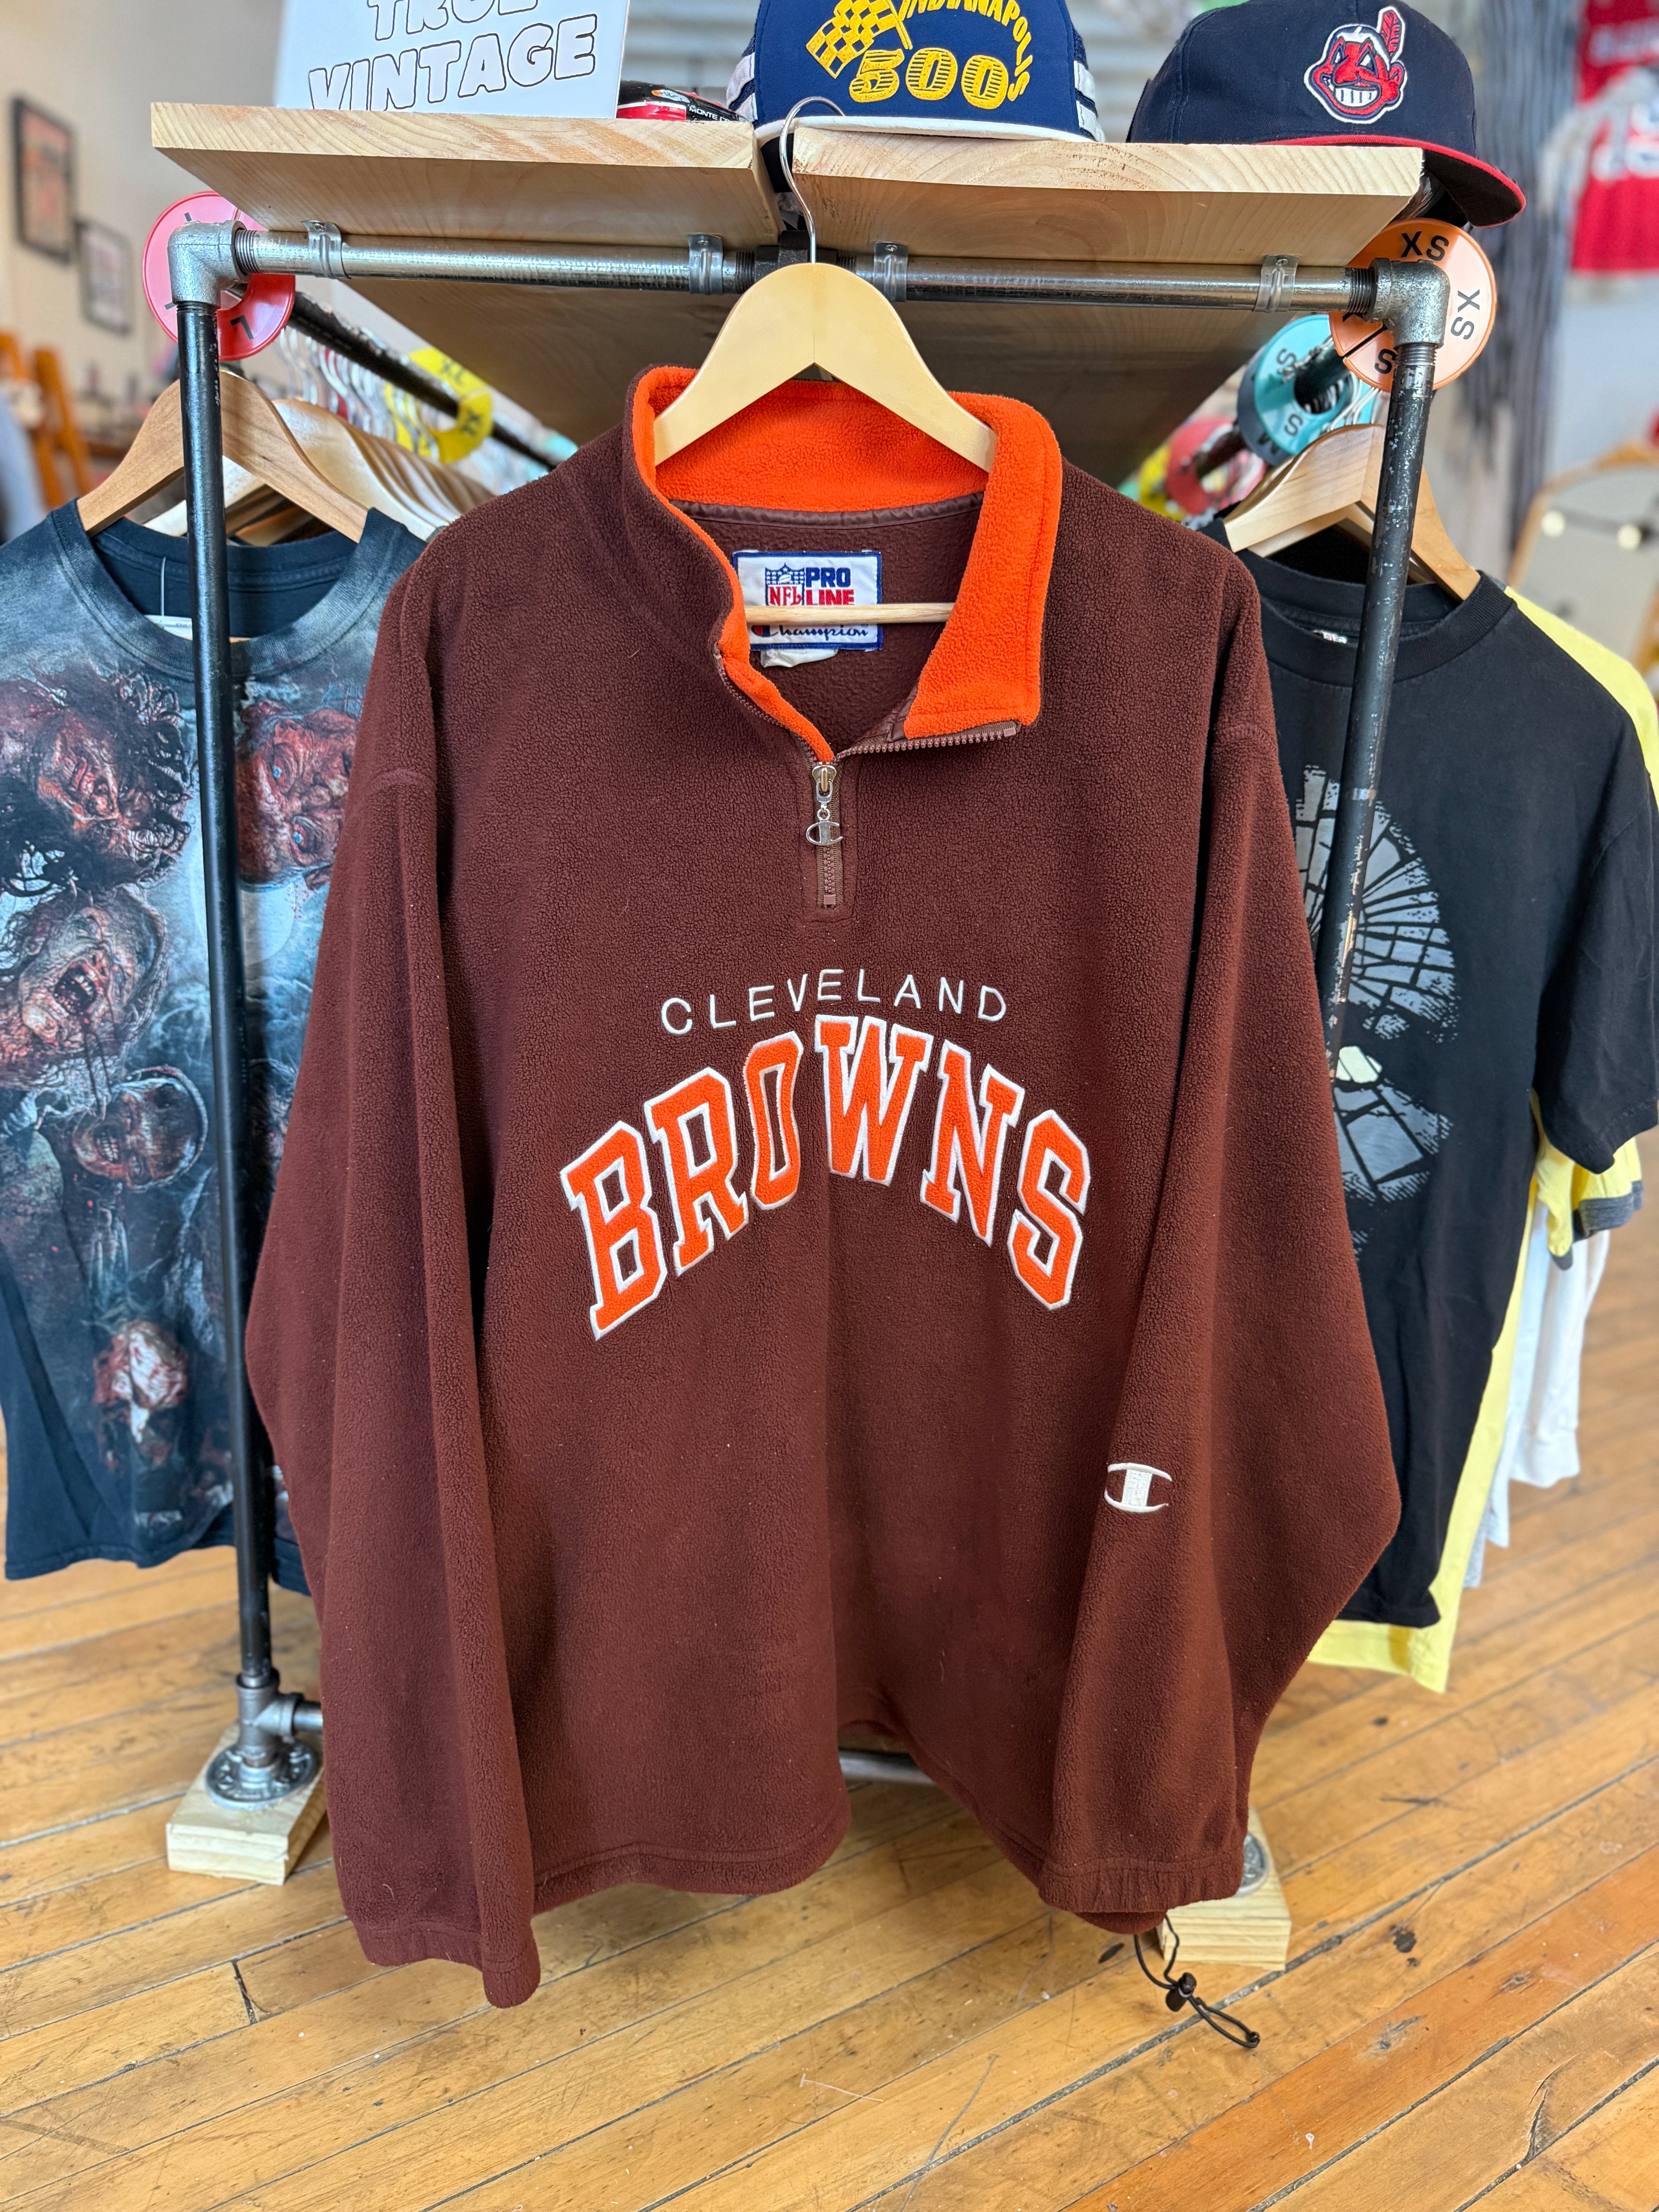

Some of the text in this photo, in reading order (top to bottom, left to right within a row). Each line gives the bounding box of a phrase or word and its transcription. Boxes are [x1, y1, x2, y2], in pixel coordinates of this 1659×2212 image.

[368, 0, 539, 41] TR
[308, 14, 597, 111] VINTAGE
[849, 47, 1009, 110] 500
[689, 106, 718, 120] MONTE
[1401, 231, 1449, 261] XS
[229, 315, 254, 340] L
[1450, 289, 1480, 340] XS
[805, 567, 851, 588] PRO
[769, 586, 802, 606] NFL
[805, 589, 855, 605] LINE
[661, 968, 1007, 1035] CLEVELAND
[560, 1014, 1092, 1341] BROWNS
